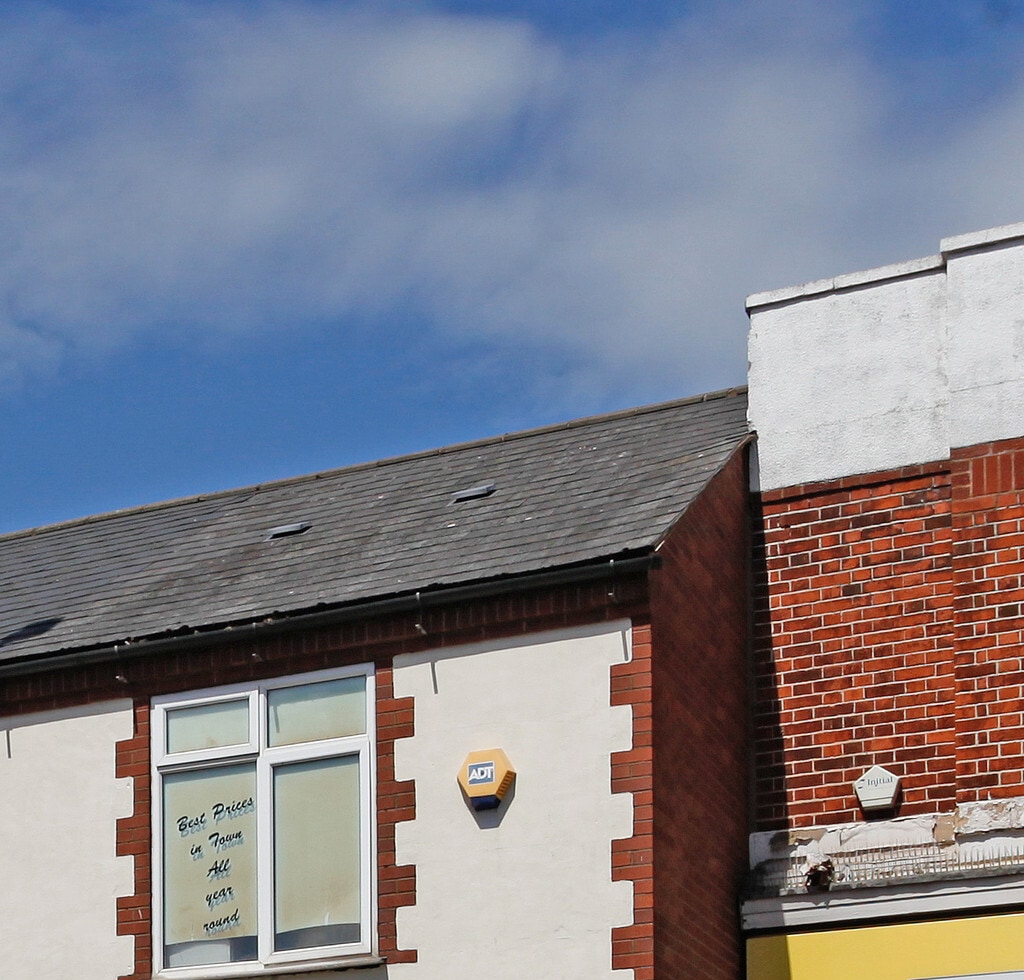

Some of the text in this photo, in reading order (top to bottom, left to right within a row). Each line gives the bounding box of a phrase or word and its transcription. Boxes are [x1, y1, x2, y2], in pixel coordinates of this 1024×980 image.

[469, 766, 494, 781] ADT
[177, 797, 254, 832] Best Prices
[190, 830, 243, 856] in Town
[206, 858, 230, 877] All
[205, 886, 233, 906] year
[203, 908, 239, 932] round
